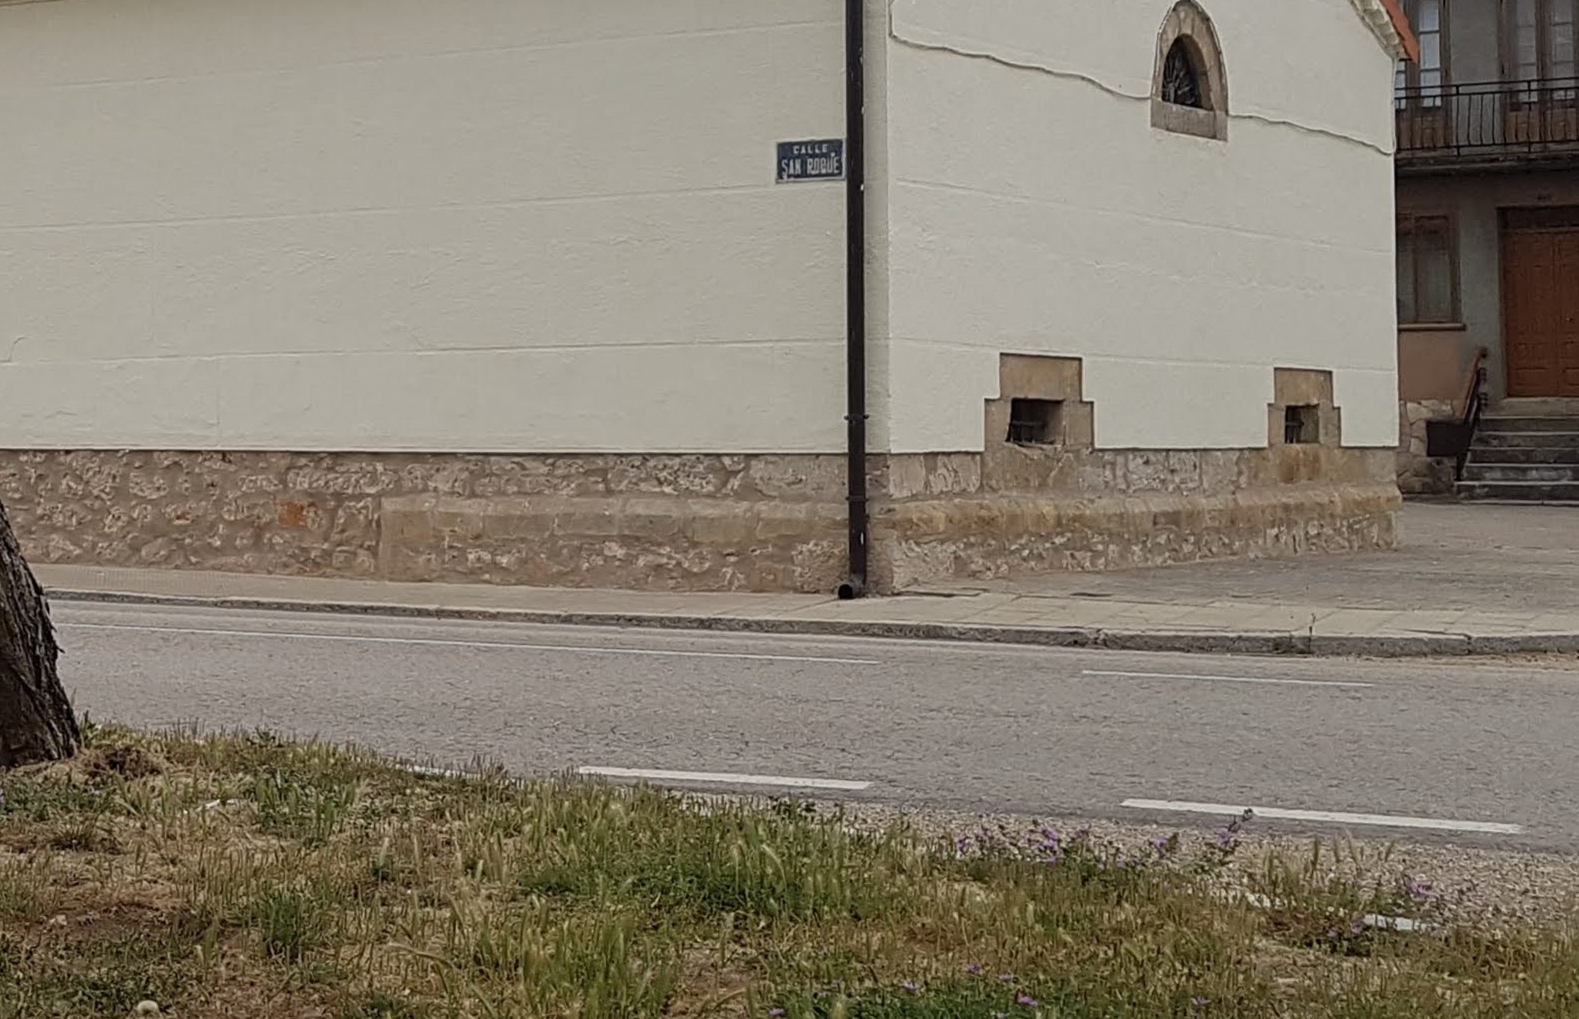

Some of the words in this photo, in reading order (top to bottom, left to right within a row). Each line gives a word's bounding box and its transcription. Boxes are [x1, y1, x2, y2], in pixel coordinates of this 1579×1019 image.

[793, 144, 829, 154] CALLE
[781, 159, 802, 175] SAN
[807, 156, 840, 174] ROQUE
